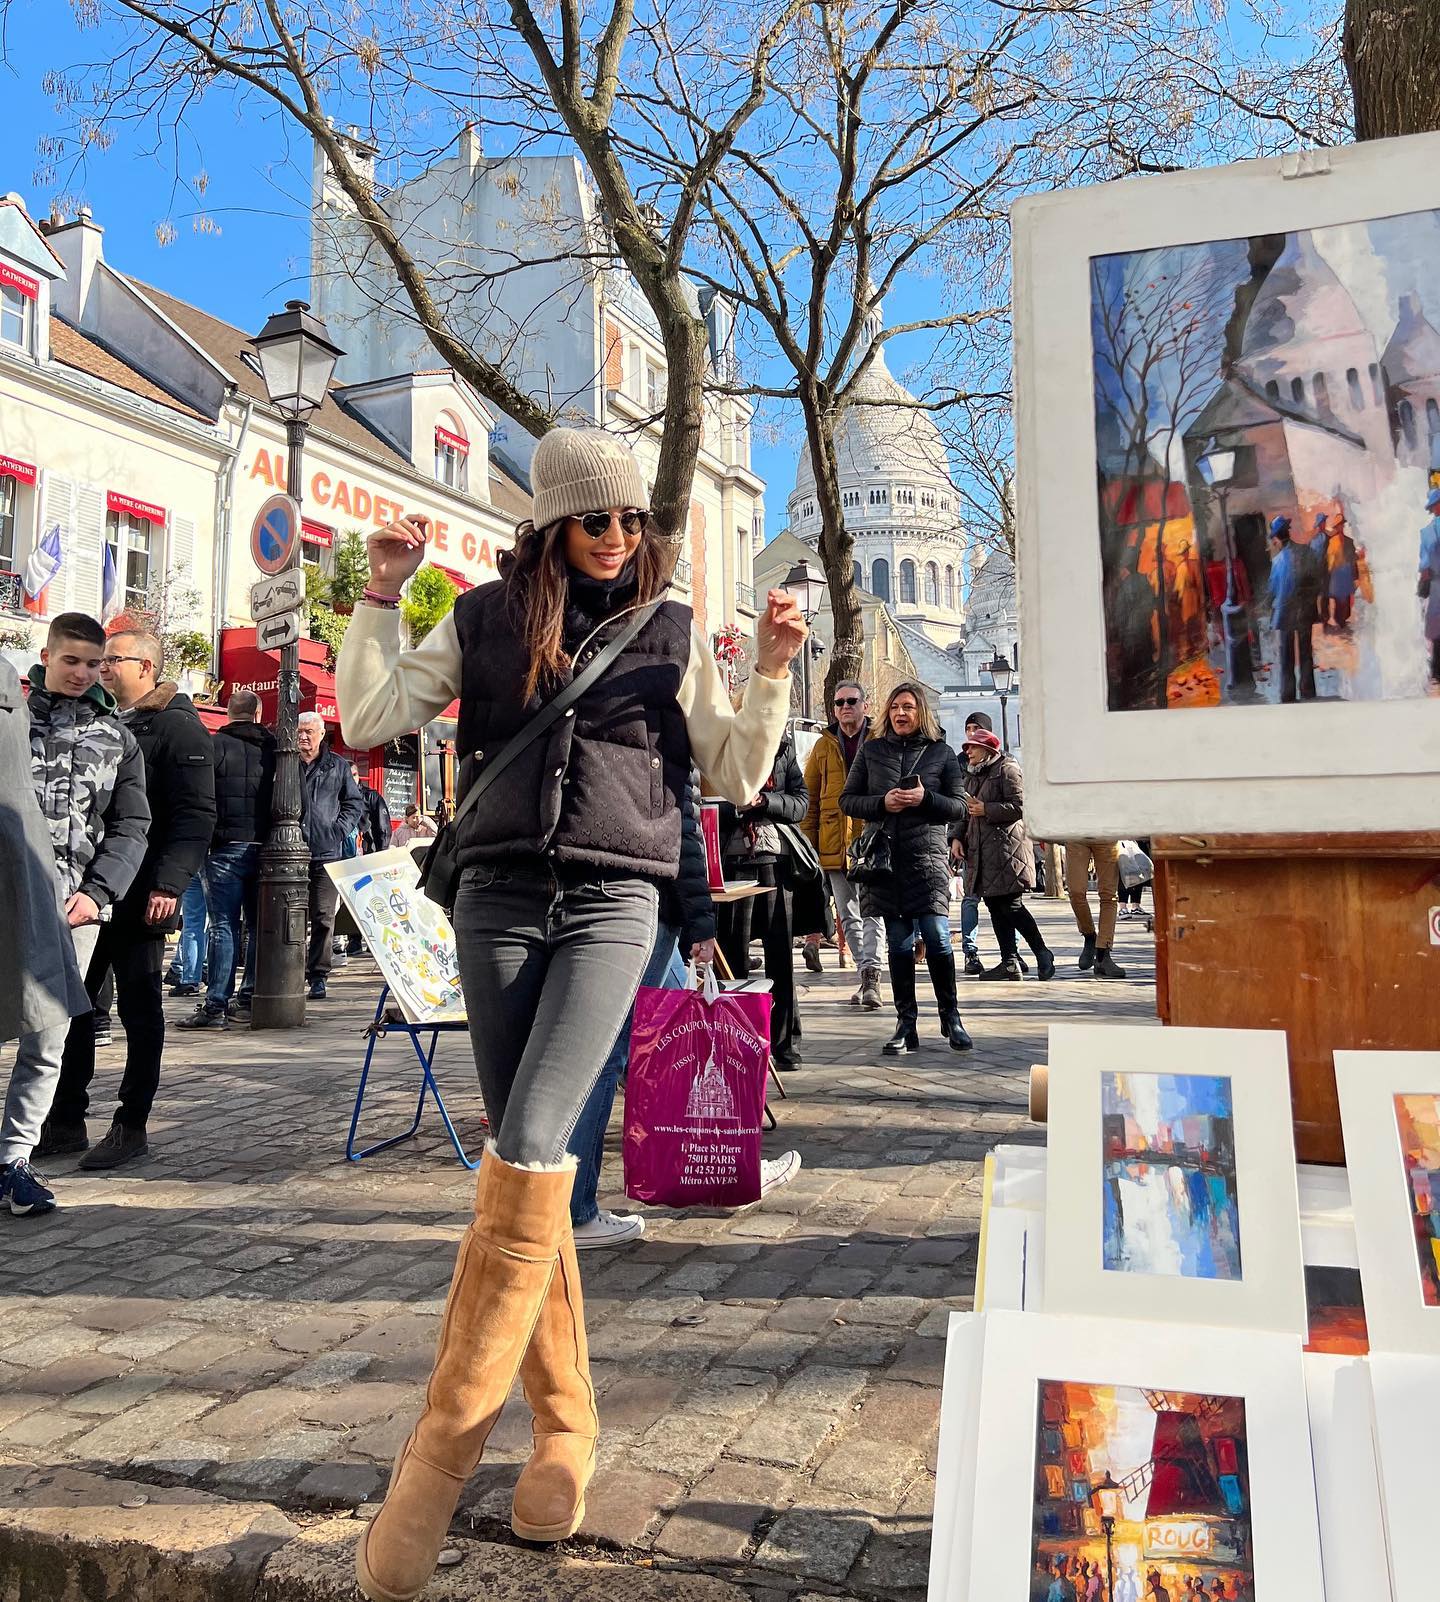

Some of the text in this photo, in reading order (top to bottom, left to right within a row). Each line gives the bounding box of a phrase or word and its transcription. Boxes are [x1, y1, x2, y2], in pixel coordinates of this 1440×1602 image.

[311, 472, 404, 528] CADET
[315, 703, 336, 717] Café
[655, 1033, 673, 1052] LES
[672, 1020, 713, 1038] COUPONS
[724, 1023, 735, 1036] ST
[735, 1029, 763, 1057] PIERRE
[672, 1052, 696, 1071] TISSUS
[690, 1143, 708, 1153] Place
[710, 1143, 718, 1153] St
[720, 1144, 741, 1153] Pierre
[687, 1154, 736, 1164] 75018 PARIS
[684, 1165, 737, 1175] 01 42 52 10 79
[680, 1176, 738, 1185] Métro ANVERS
